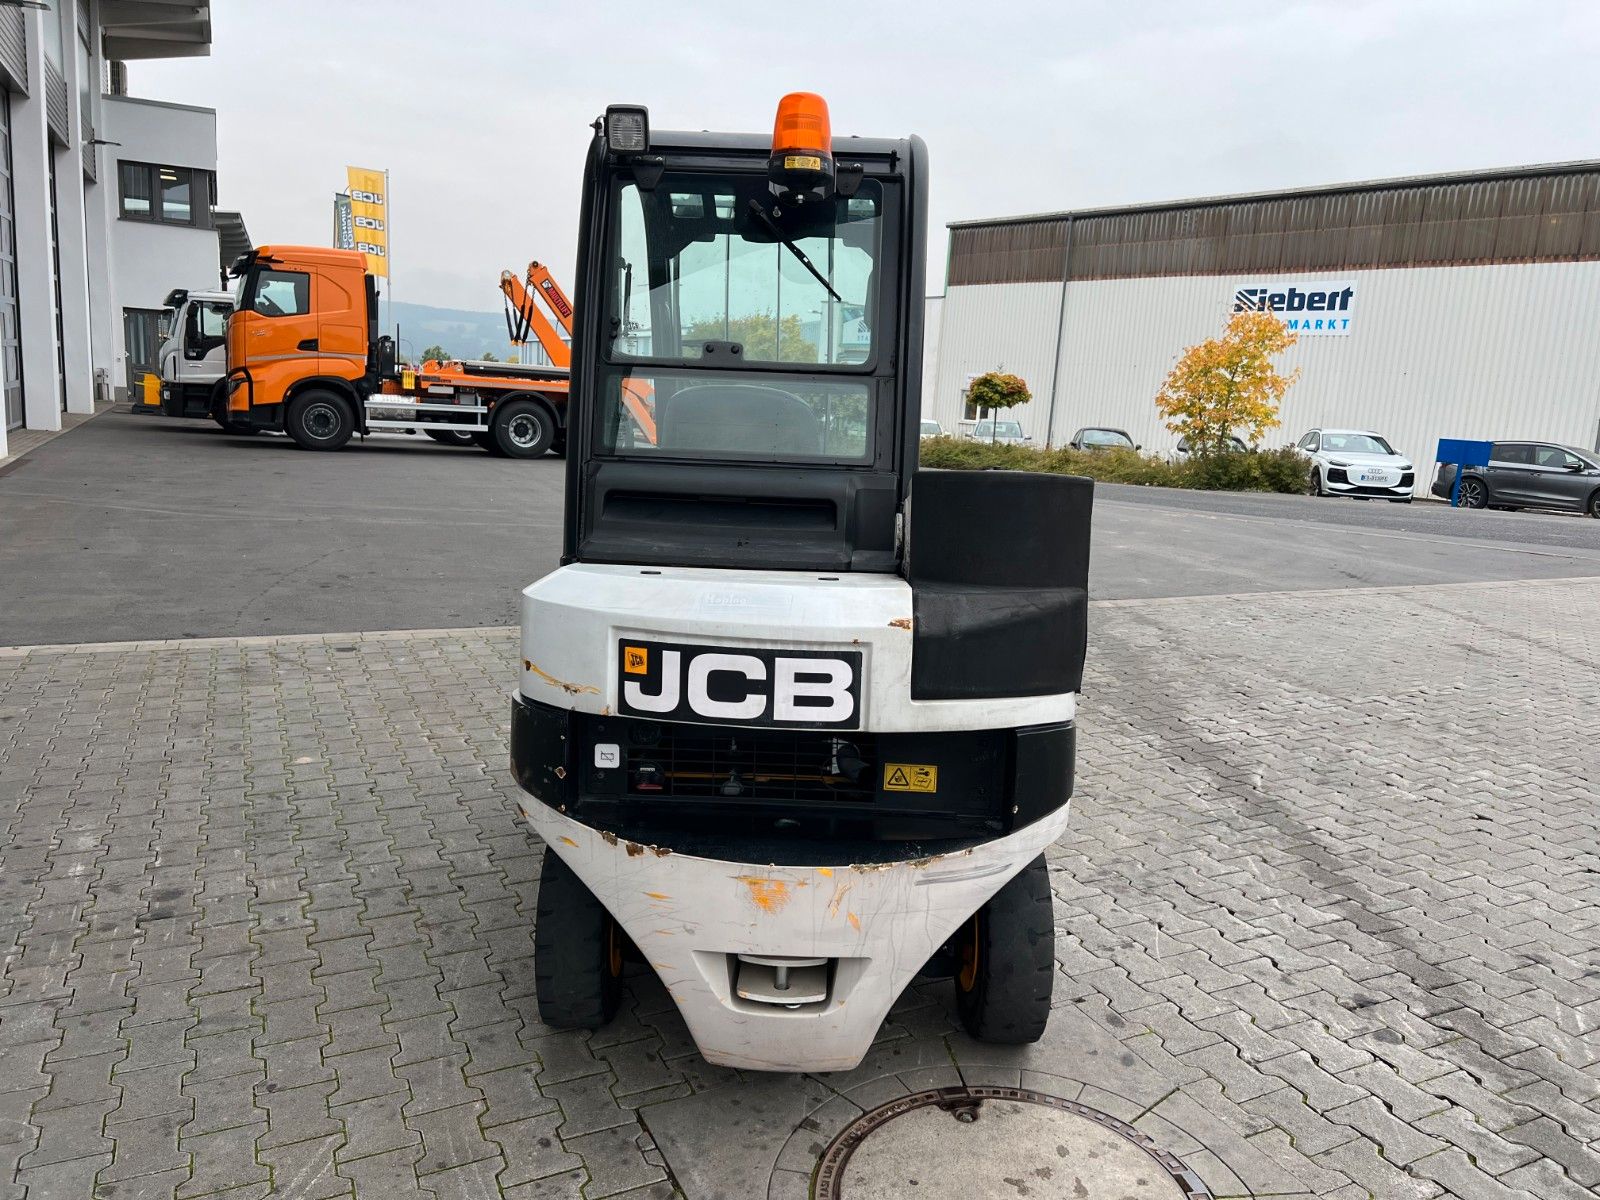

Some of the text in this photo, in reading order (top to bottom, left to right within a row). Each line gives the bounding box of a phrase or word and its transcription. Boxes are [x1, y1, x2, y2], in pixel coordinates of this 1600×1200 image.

[1234, 287, 1354, 312] Siebert
[629, 653, 645, 667] JCB
[624, 650, 855, 723] JCB
